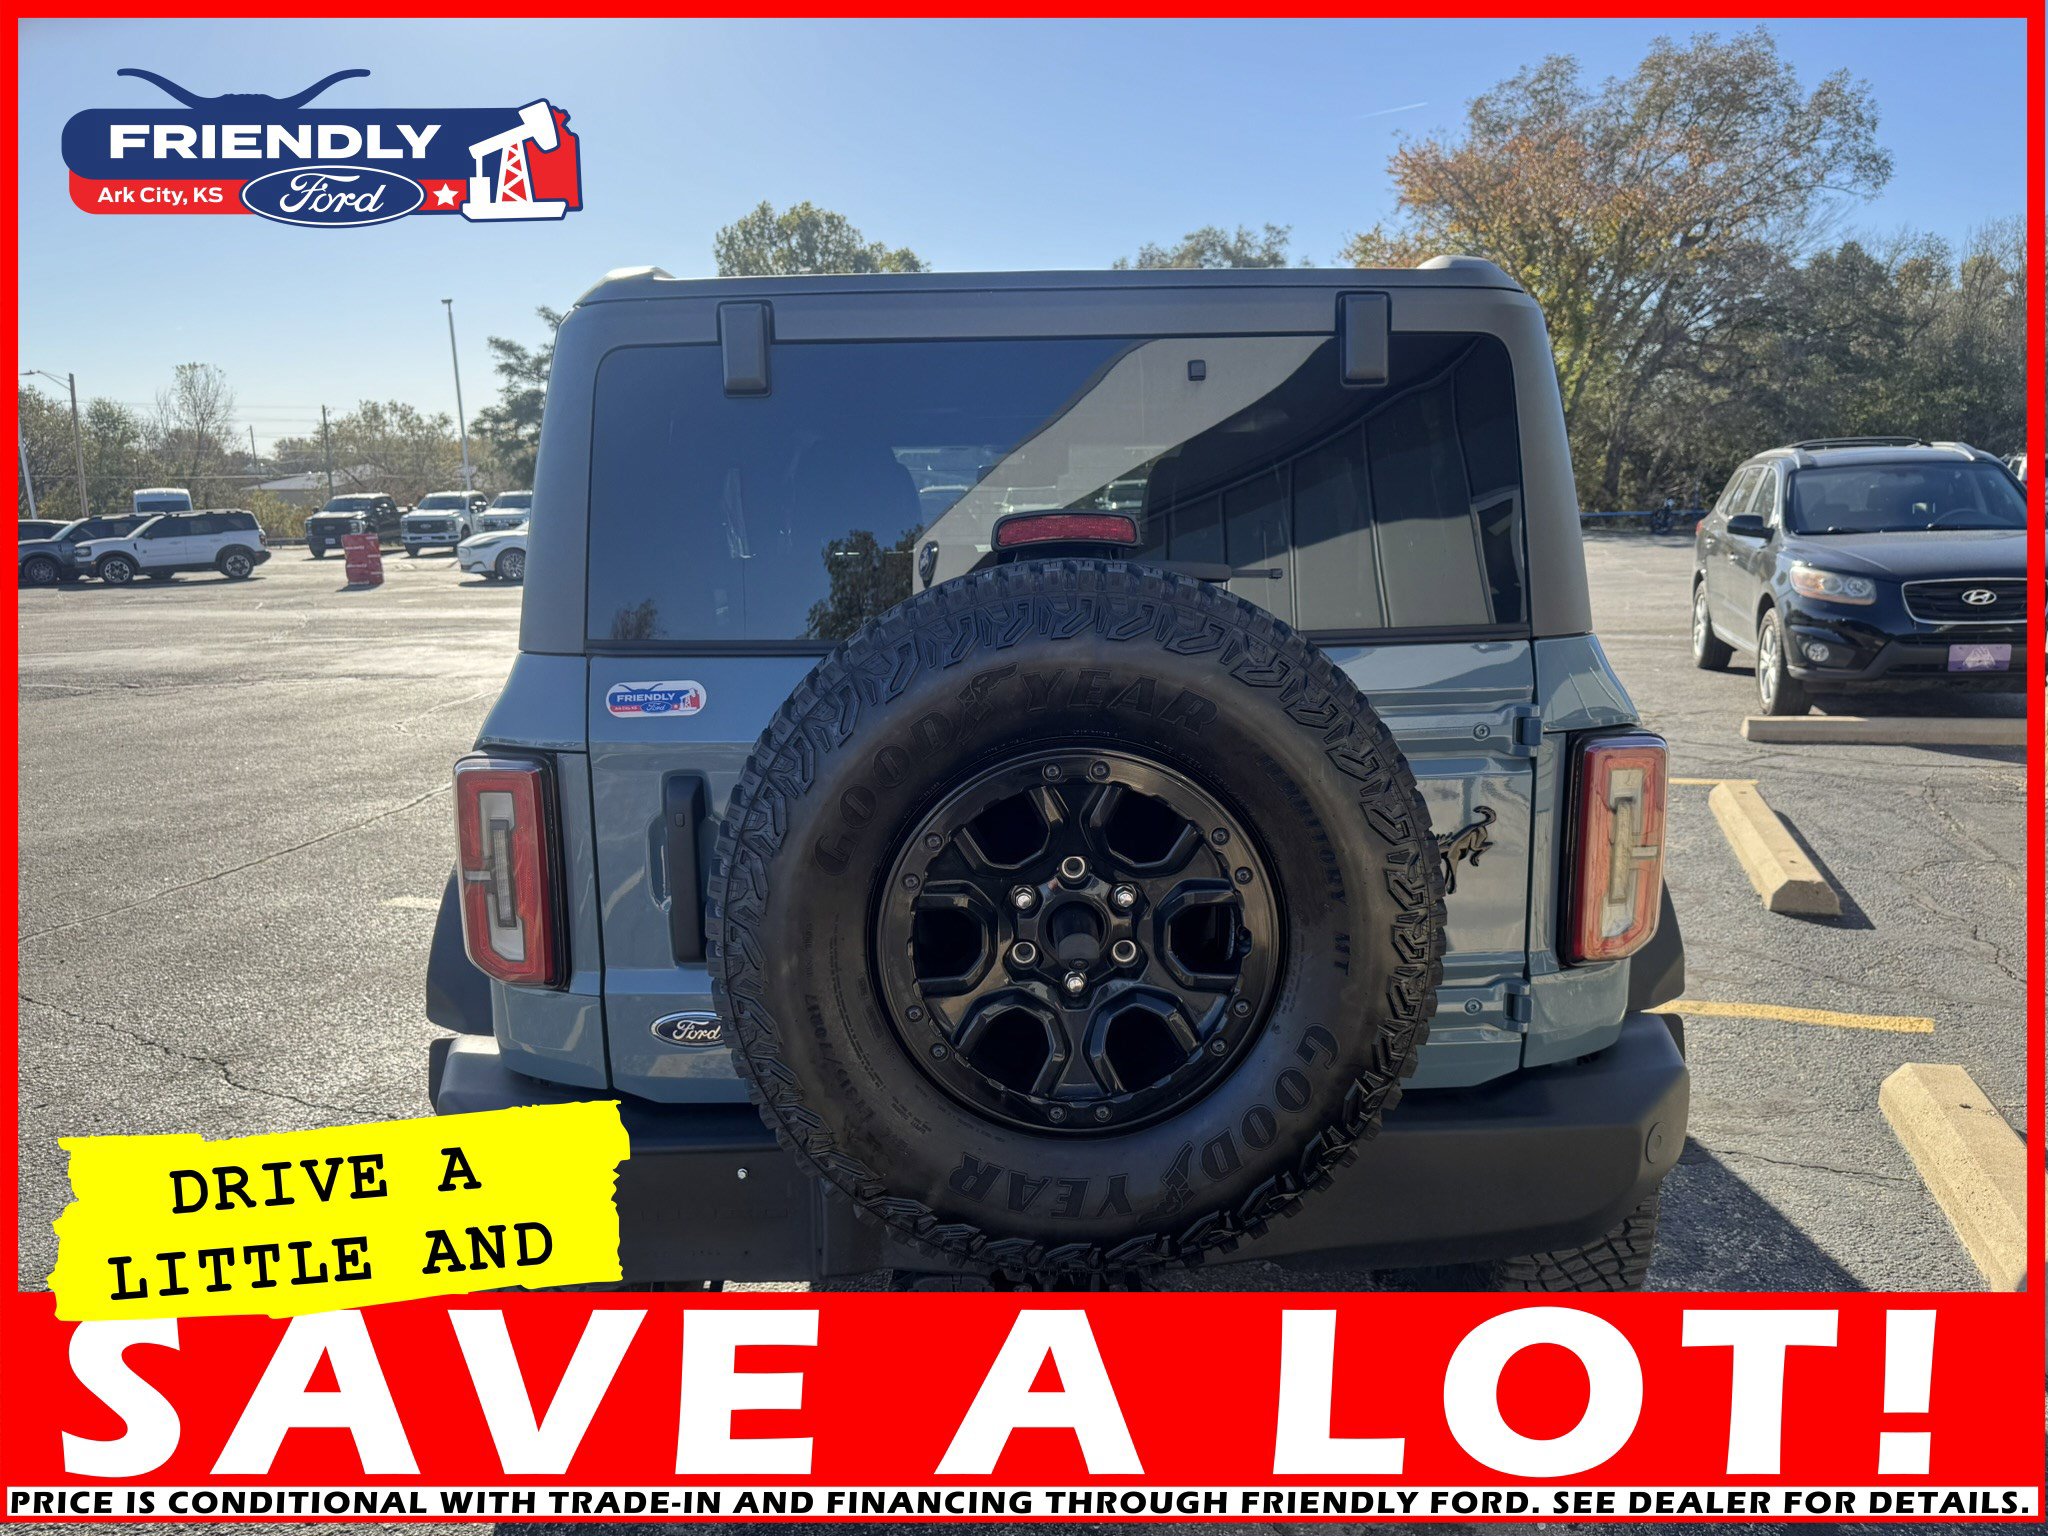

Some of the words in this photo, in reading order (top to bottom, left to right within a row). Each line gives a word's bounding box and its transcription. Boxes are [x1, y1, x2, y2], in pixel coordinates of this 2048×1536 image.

[616, 693, 675, 702] FRIENDLY
[646, 702, 666, 711] Ford
[673, 1019, 721, 1040] Ford
